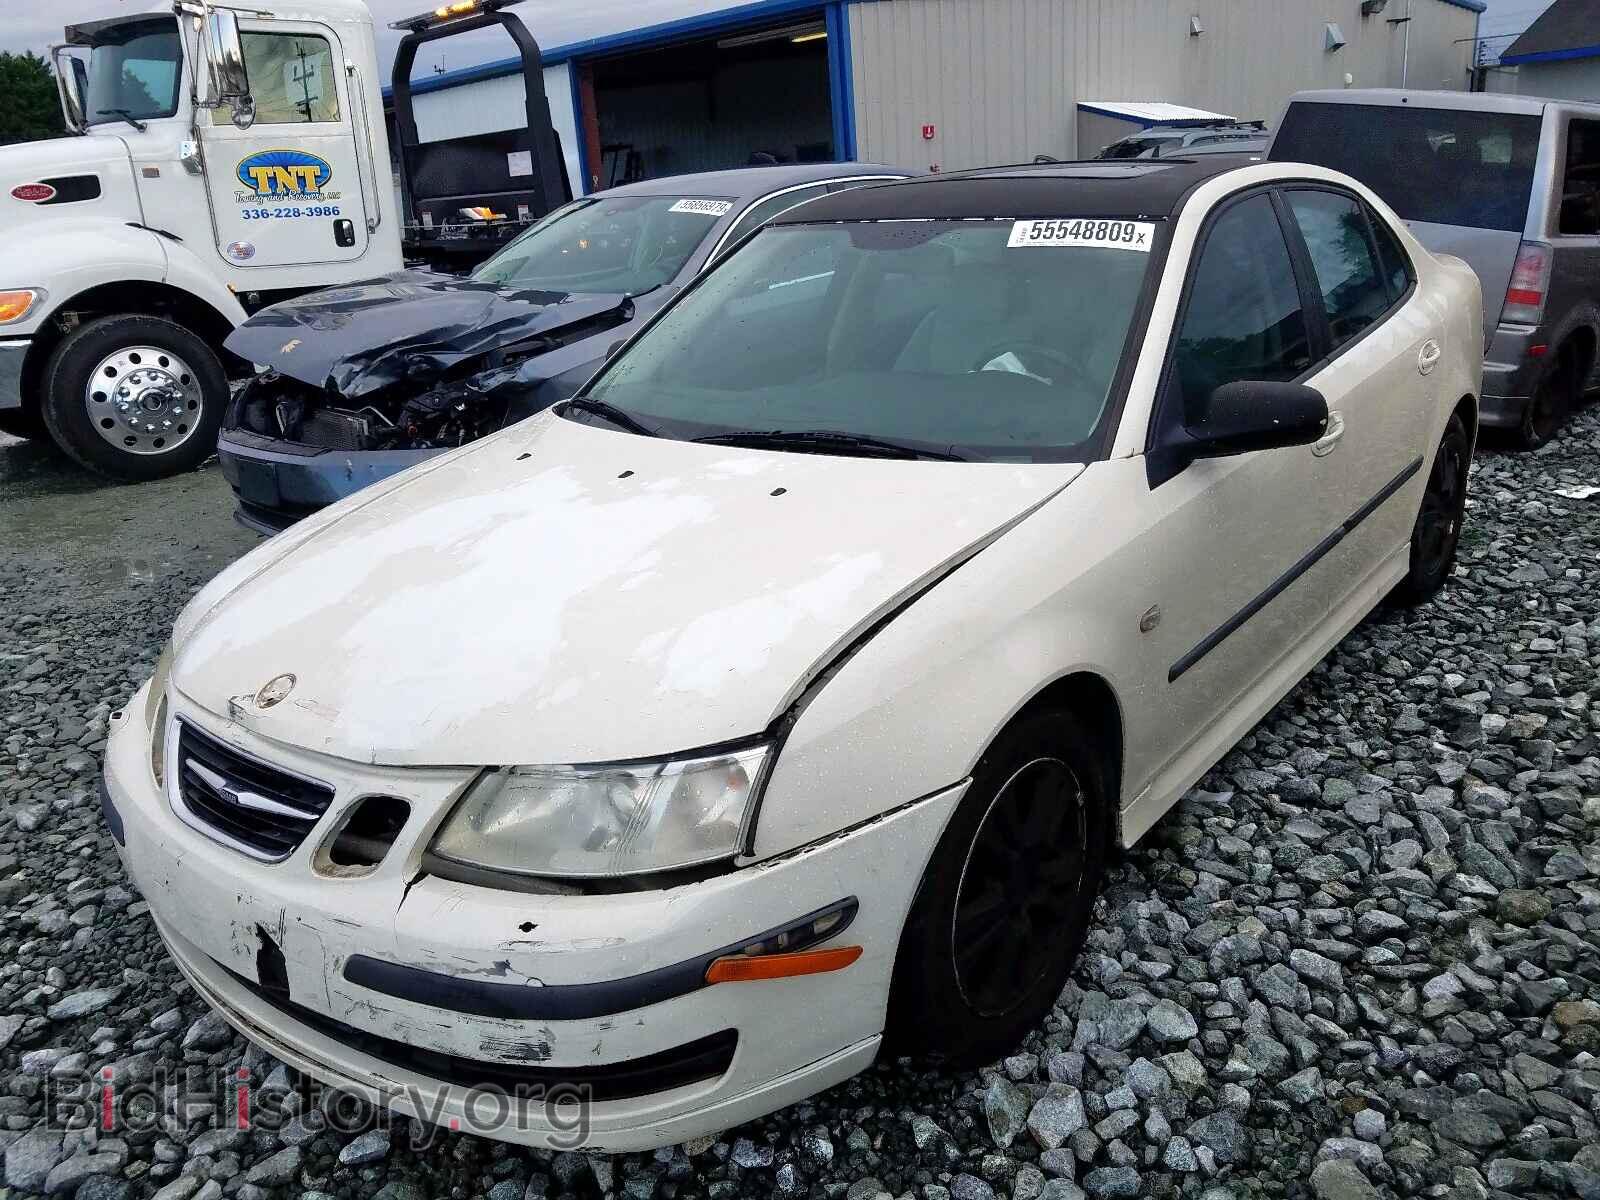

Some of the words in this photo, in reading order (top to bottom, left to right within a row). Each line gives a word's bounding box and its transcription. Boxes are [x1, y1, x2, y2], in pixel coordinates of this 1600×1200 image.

[249, 165, 321, 194] TNT
[234, 191, 265, 205] Towing
[266, 189, 285, 203] and
[241, 206, 341, 220] 336-228-3986
[1029, 221, 1136, 243] 55548809
